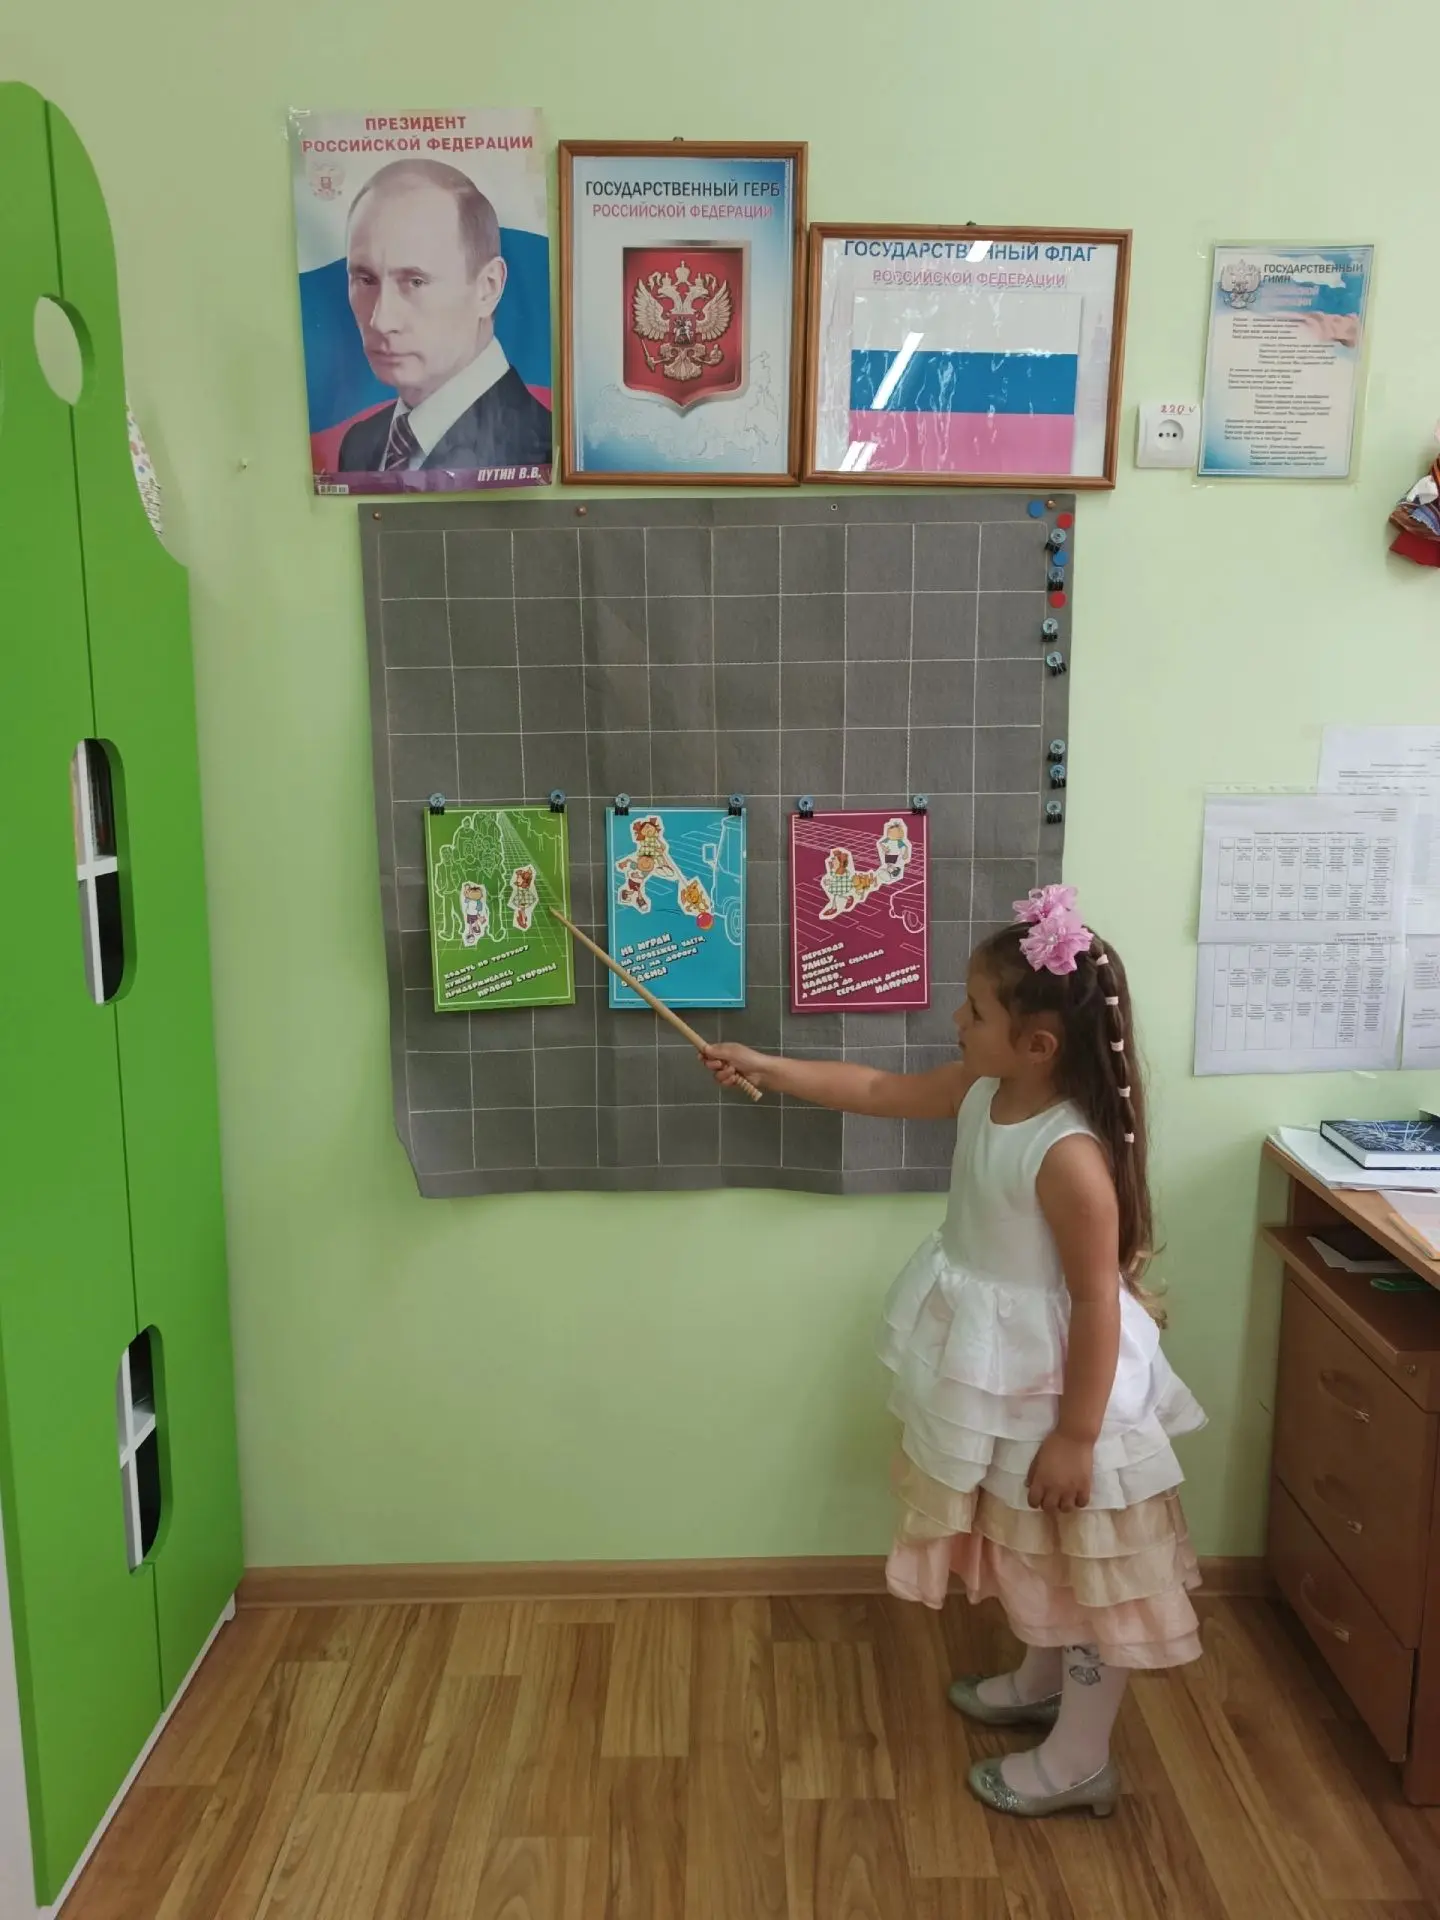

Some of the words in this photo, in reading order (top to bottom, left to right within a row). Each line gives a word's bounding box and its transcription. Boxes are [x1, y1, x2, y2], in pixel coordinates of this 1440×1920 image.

[365, 116, 467, 132] ПРЕЗИДЕНТ
[302, 135, 421, 153] РОССИЙСКОЙ
[426, 136, 533, 152] ФЕДЕРАЦИИ
[585, 177, 739, 199] ГОСУДАРСТВЕННЫЙ
[743, 182, 781, 197] ГЕРБ
[592, 201, 686, 218] РОССИЙСКОЙ
[689, 204, 773, 220] ФЕДЕРАЦИИ
[844, 240, 1039, 261] ГОСУДАРСТВННЫЙ
[1045, 245, 1098, 262] ФЛАГ
[1264, 263, 1363, 274] ГОСУДАРСТВЕННЫЙ
[873, 269, 972, 285] РОССИЙСКОЙ
[976, 272, 1066, 288] ФЕДЕРАЦИИ
[1263, 275, 1291, 283] ГИМН
[477, 467, 515, 482] ПУТИН
[518, 466, 542, 480] В.В.
[620, 945, 635, 957] НЕ
[620, 958, 633, 968] НА
[875, 973, 920, 994] НАПРАВО
